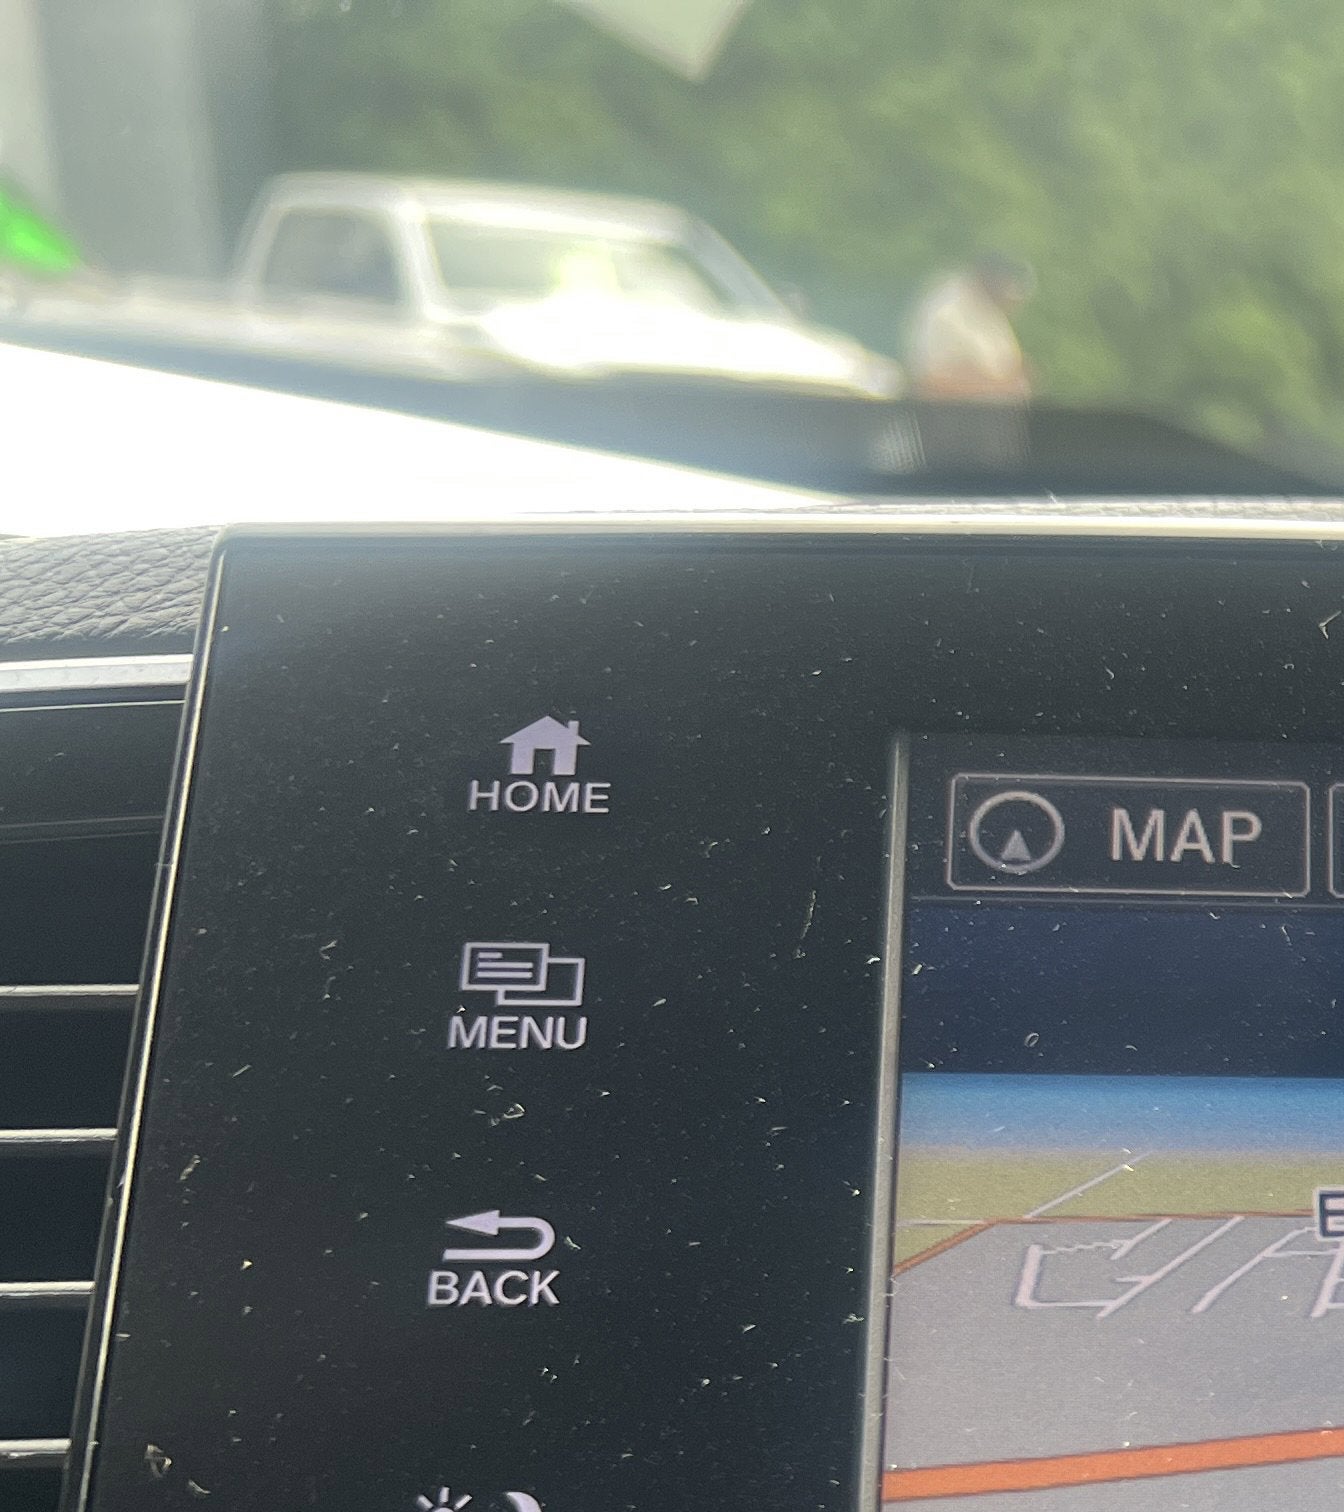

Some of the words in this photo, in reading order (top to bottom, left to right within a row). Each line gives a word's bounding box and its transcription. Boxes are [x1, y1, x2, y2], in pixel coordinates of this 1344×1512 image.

[468, 779, 612, 814] HOME
[1110, 807, 1263, 865] MAP
[448, 1015, 588, 1050] MENU
[426, 1270, 560, 1305] BACK
